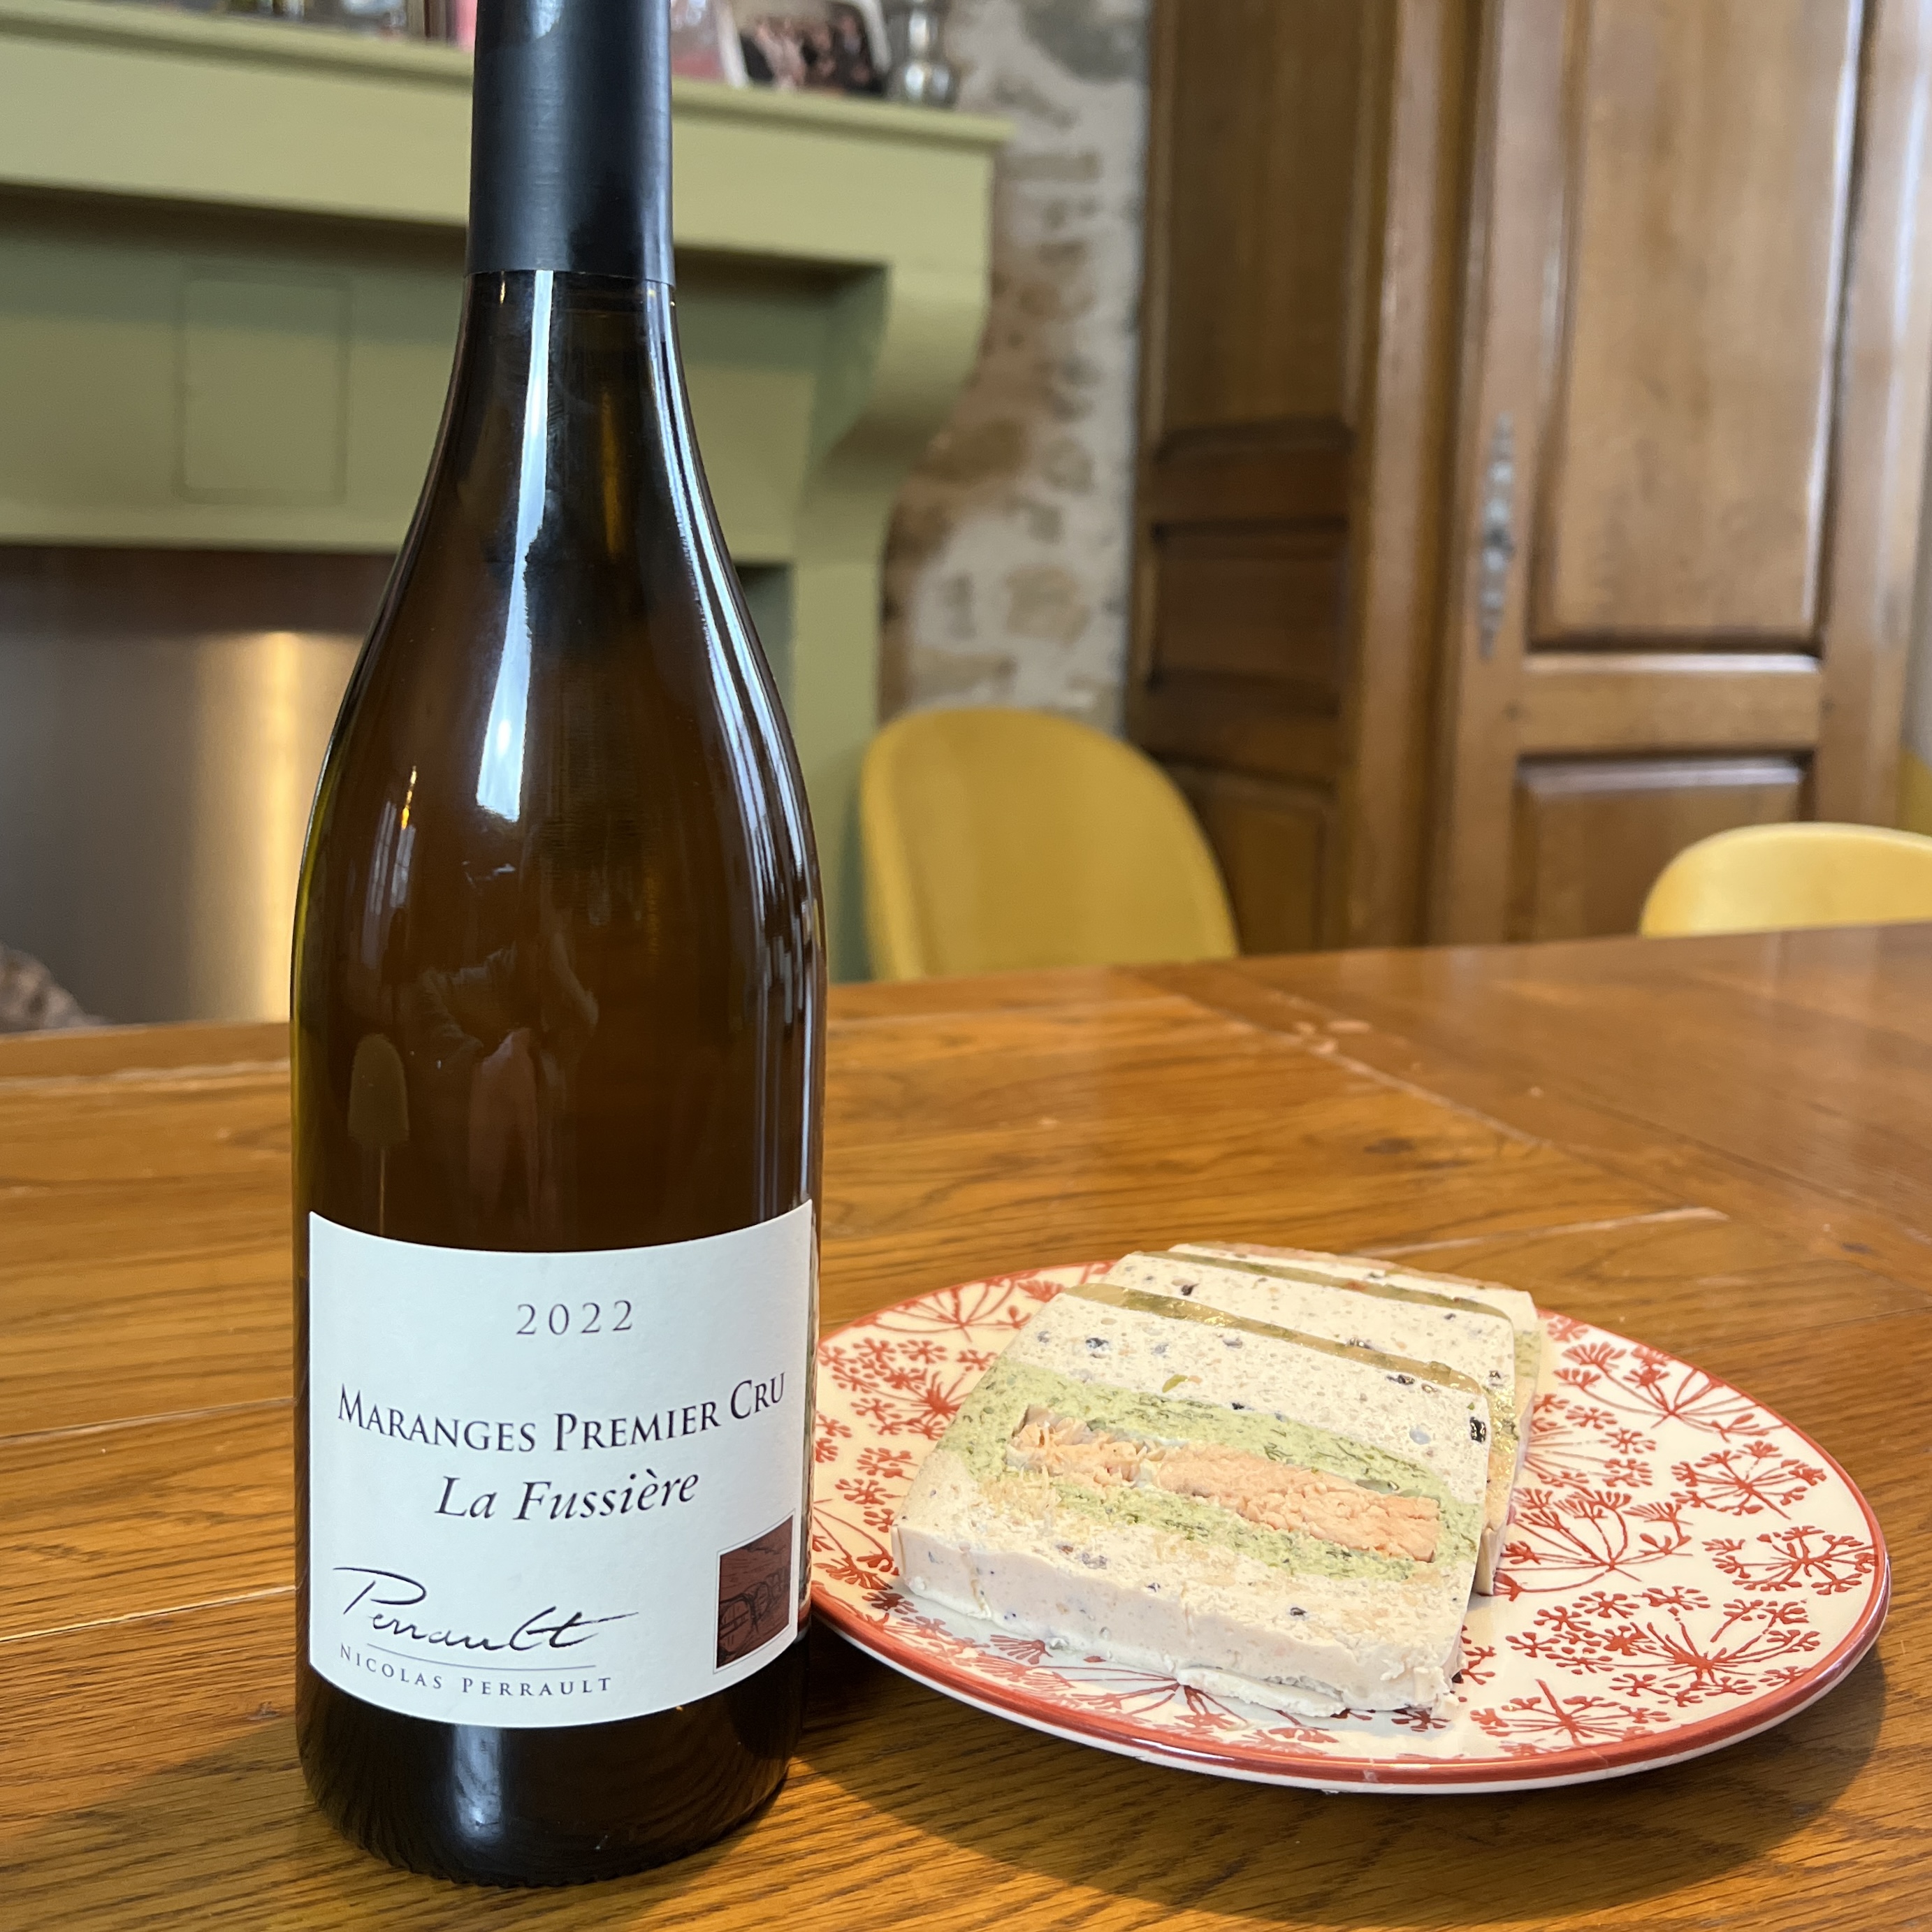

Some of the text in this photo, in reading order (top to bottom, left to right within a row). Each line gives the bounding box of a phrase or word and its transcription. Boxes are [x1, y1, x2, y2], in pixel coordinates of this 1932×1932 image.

[516, 1300, 633, 1336] 2022
[337, 1372, 785, 1452] MARANGES PREMIER CRU
[433, 1467, 699, 1521] La Fussière
[340, 1643, 612, 1697] NICOLAS PERRAULT
